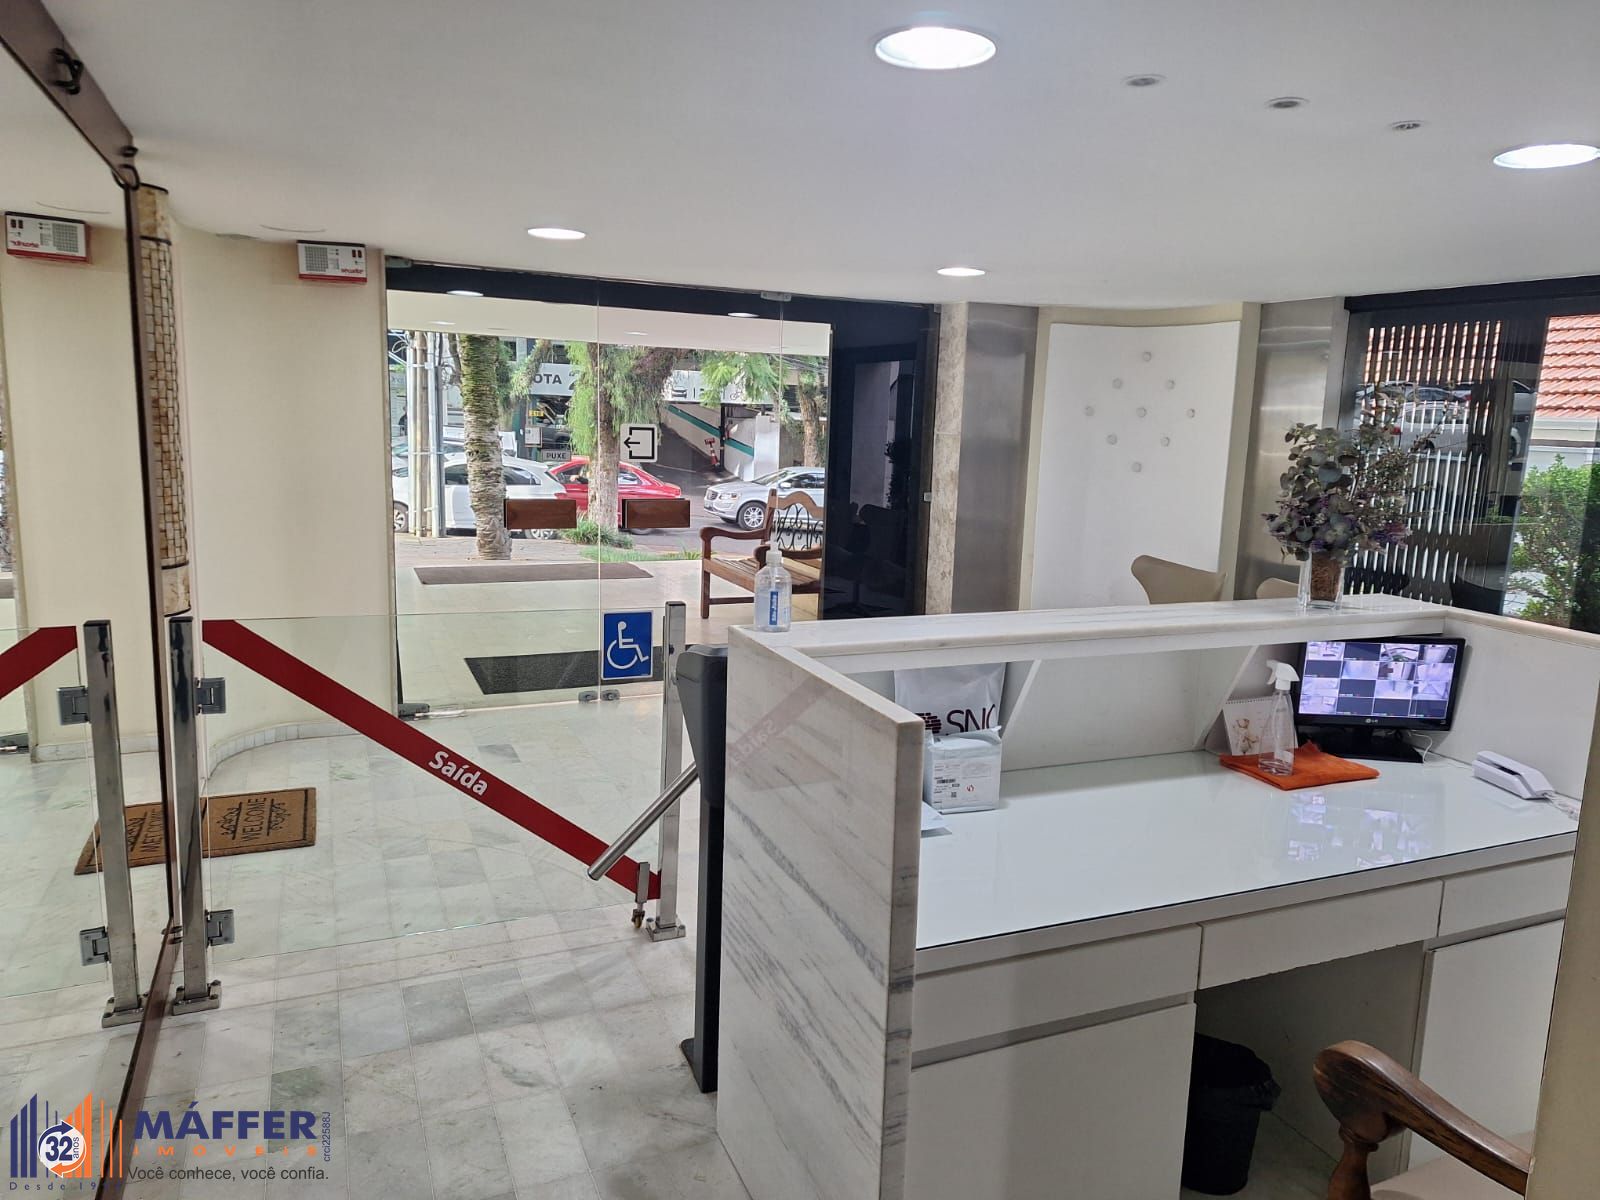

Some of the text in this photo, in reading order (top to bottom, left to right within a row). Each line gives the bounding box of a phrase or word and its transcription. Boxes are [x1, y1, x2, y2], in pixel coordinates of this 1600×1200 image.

[546, 451, 567, 460] PUXE
[427, 750, 488, 796] Saída
[240, 797, 268, 842] WELCOME
